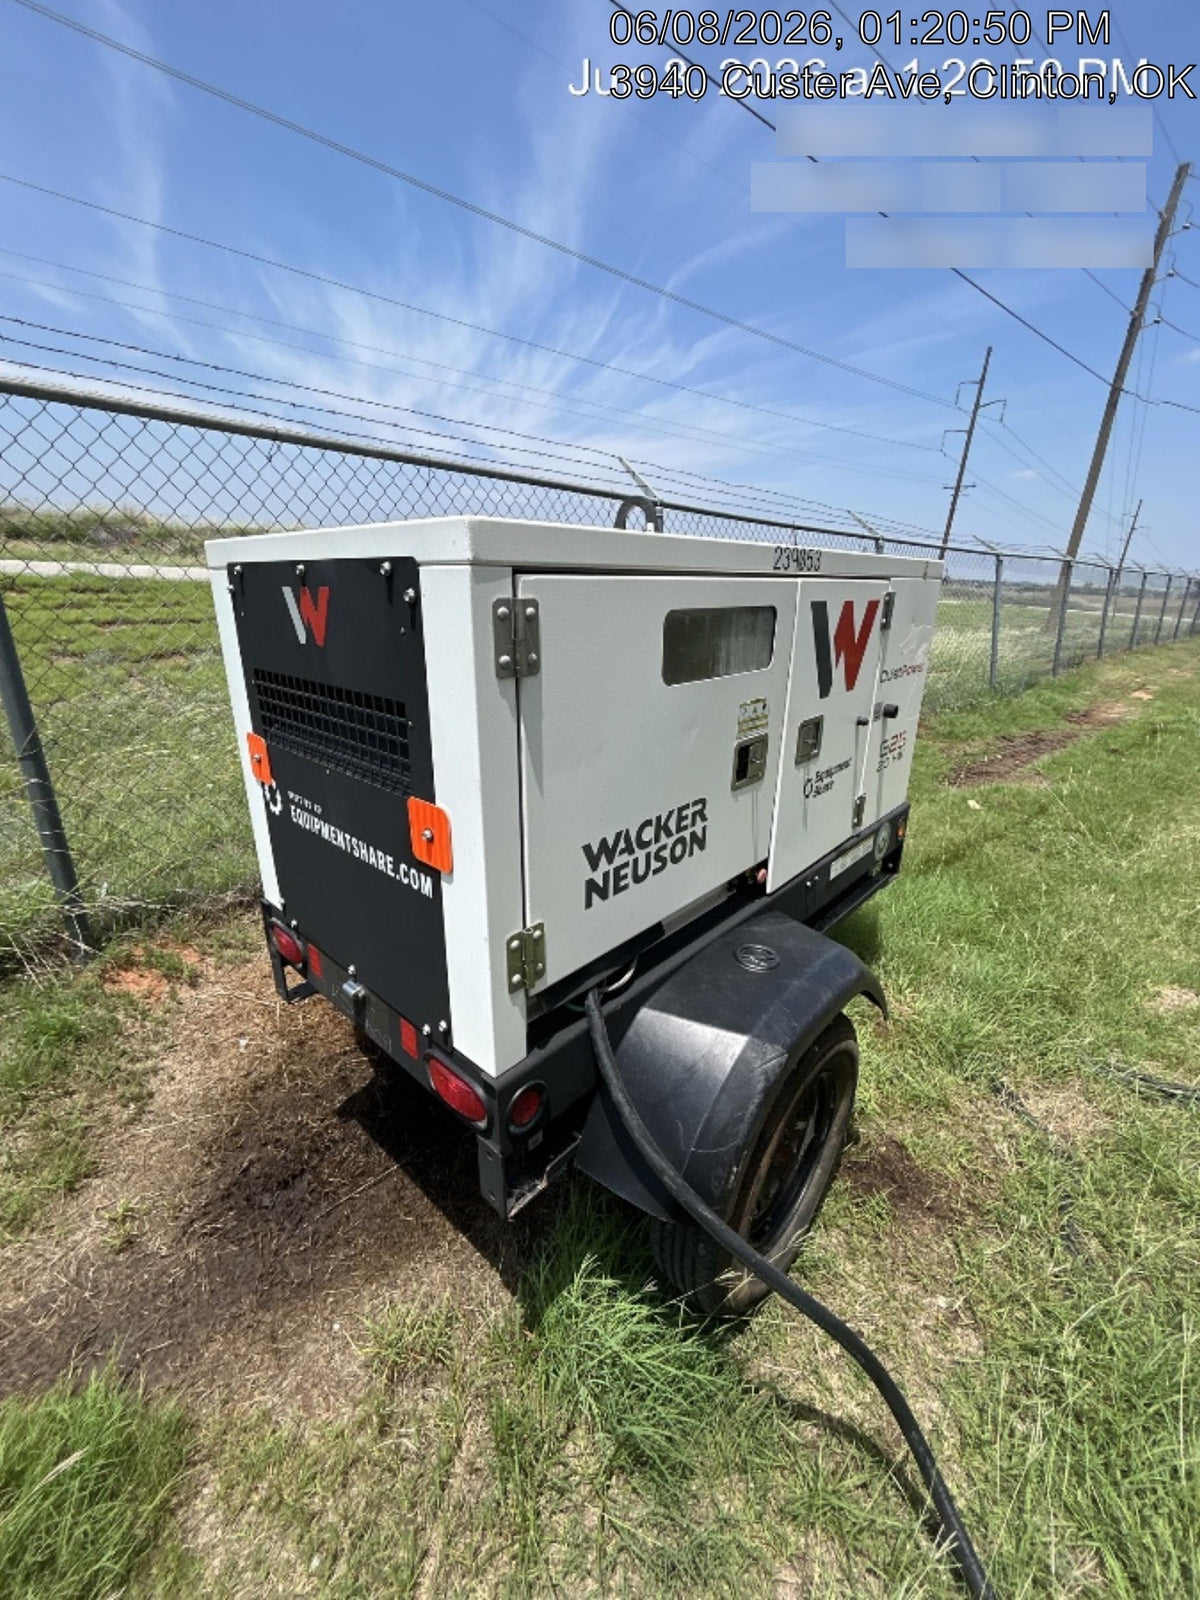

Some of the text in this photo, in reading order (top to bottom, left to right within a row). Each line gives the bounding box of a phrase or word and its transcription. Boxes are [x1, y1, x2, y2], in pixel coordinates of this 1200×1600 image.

[290, 804, 433, 898] EQUIPMENTSHARE.COM
[581, 797, 708, 873] WACKER
[584, 824, 707, 910] NEUSON
